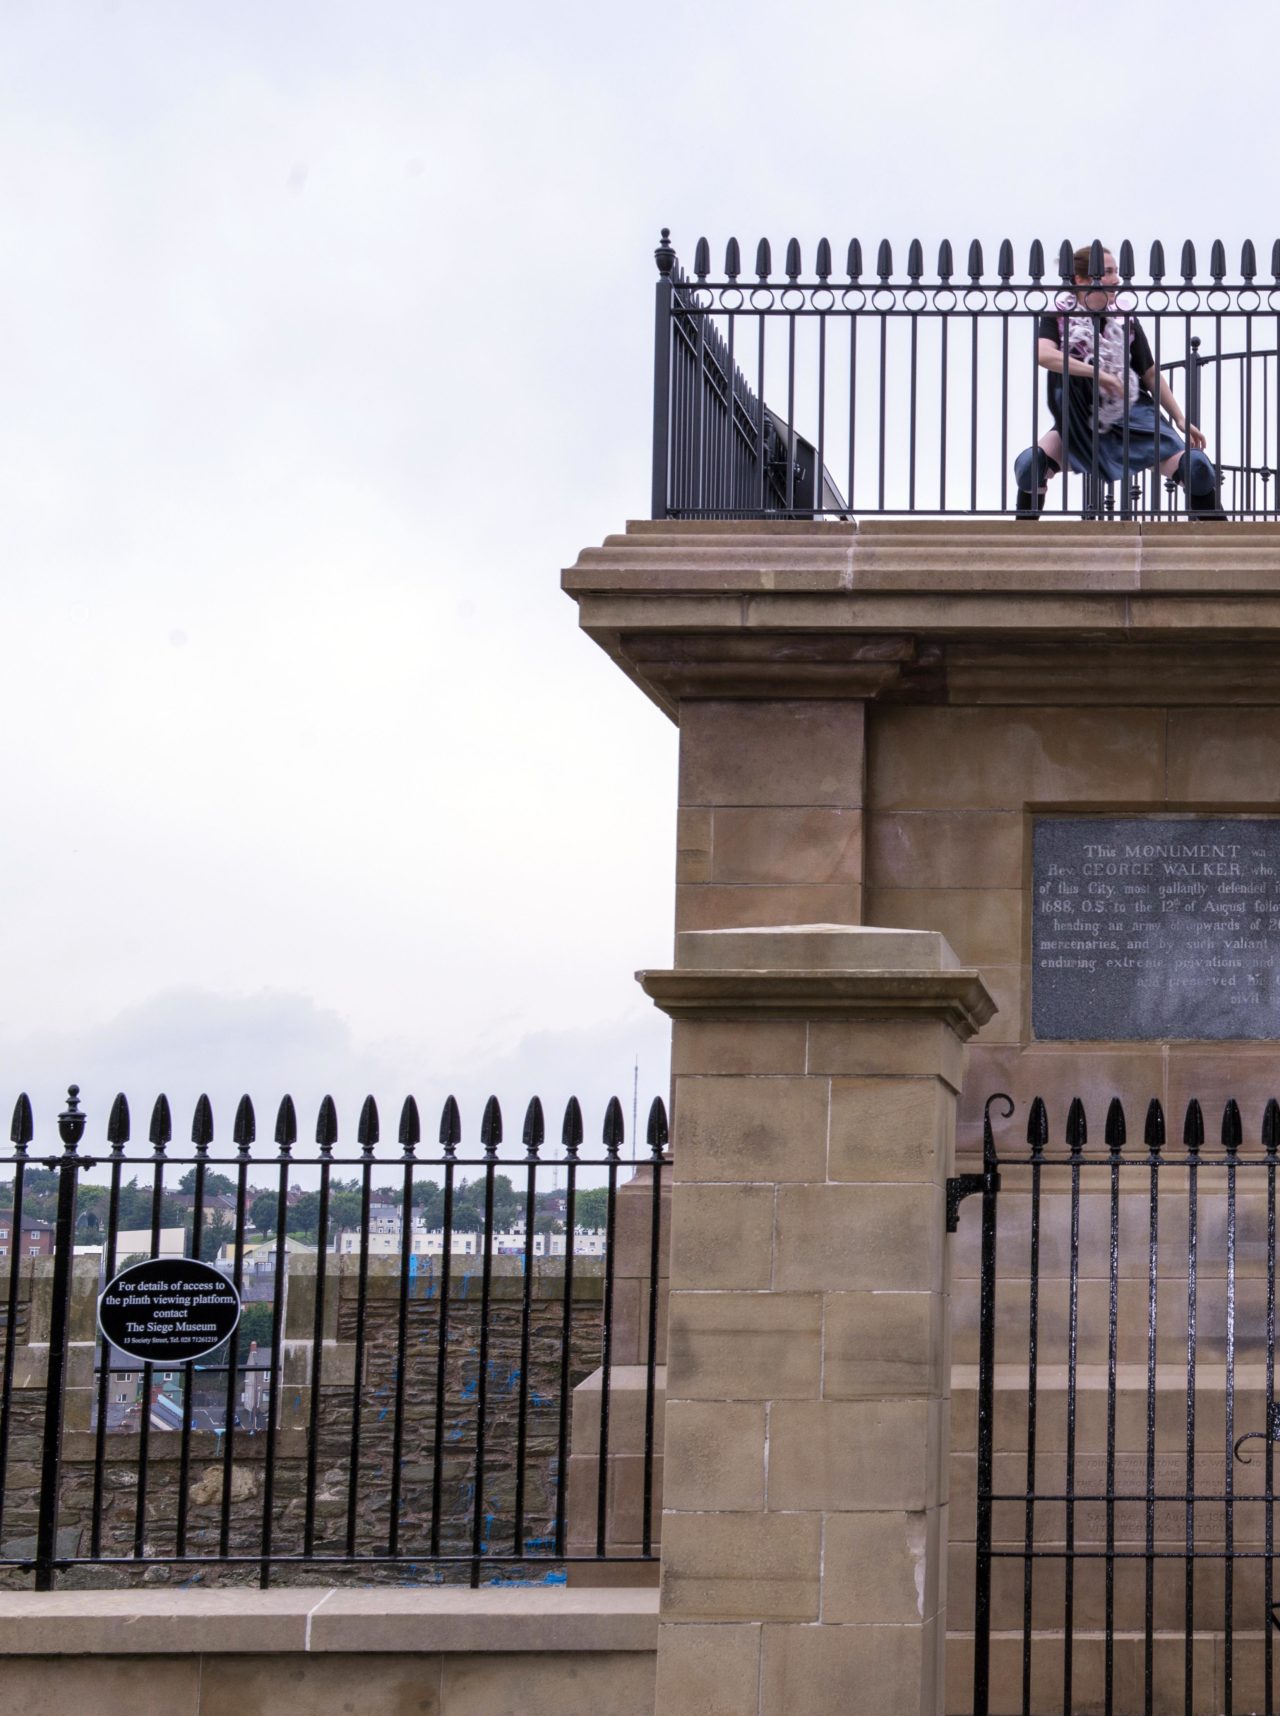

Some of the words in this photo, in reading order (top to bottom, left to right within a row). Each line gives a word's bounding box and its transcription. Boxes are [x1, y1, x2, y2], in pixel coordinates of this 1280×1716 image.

[1083, 845, 1116, 858] This
[1125, 845, 1241, 858] MONUMENT
[1082, 863, 1153, 876] GEORGE
[1039, 881, 1051, 895] of
[1058, 881, 1079, 895] this
[1158, 882, 1208, 899] gallantly
[1217, 881, 1266, 894] defended
[1114, 901, 1126, 913] to
[1135, 900, 1152, 913] the
[1184, 900, 1196, 913] of
[1204, 901, 1246, 916] August
[1053, 918, 1100, 936] heading
[1108, 921, 1123, 931] an
[1250, 918, 1261, 931] of
[1127, 938, 1150, 949] and
[1223, 937, 1268, 949] valiant
[1040, 956, 1097, 973] enduring
[118, 1282, 136, 1291] For
[137, 1281, 169, 1291] details
[170, 1281, 183, 1291] of
[215, 1282, 225, 1290] to
[106, 1295, 121, 1305] the
[122, 1294, 151, 1307] plinth
[153, 1294, 191, 1306] viewing
[192, 1294, 236, 1306] platform,
[153, 1309, 188, 1318] contact
[126, 1322, 145, 1332] The
[147, 1322, 174, 1334] Siege
[175, 1322, 217, 1331] Museum
